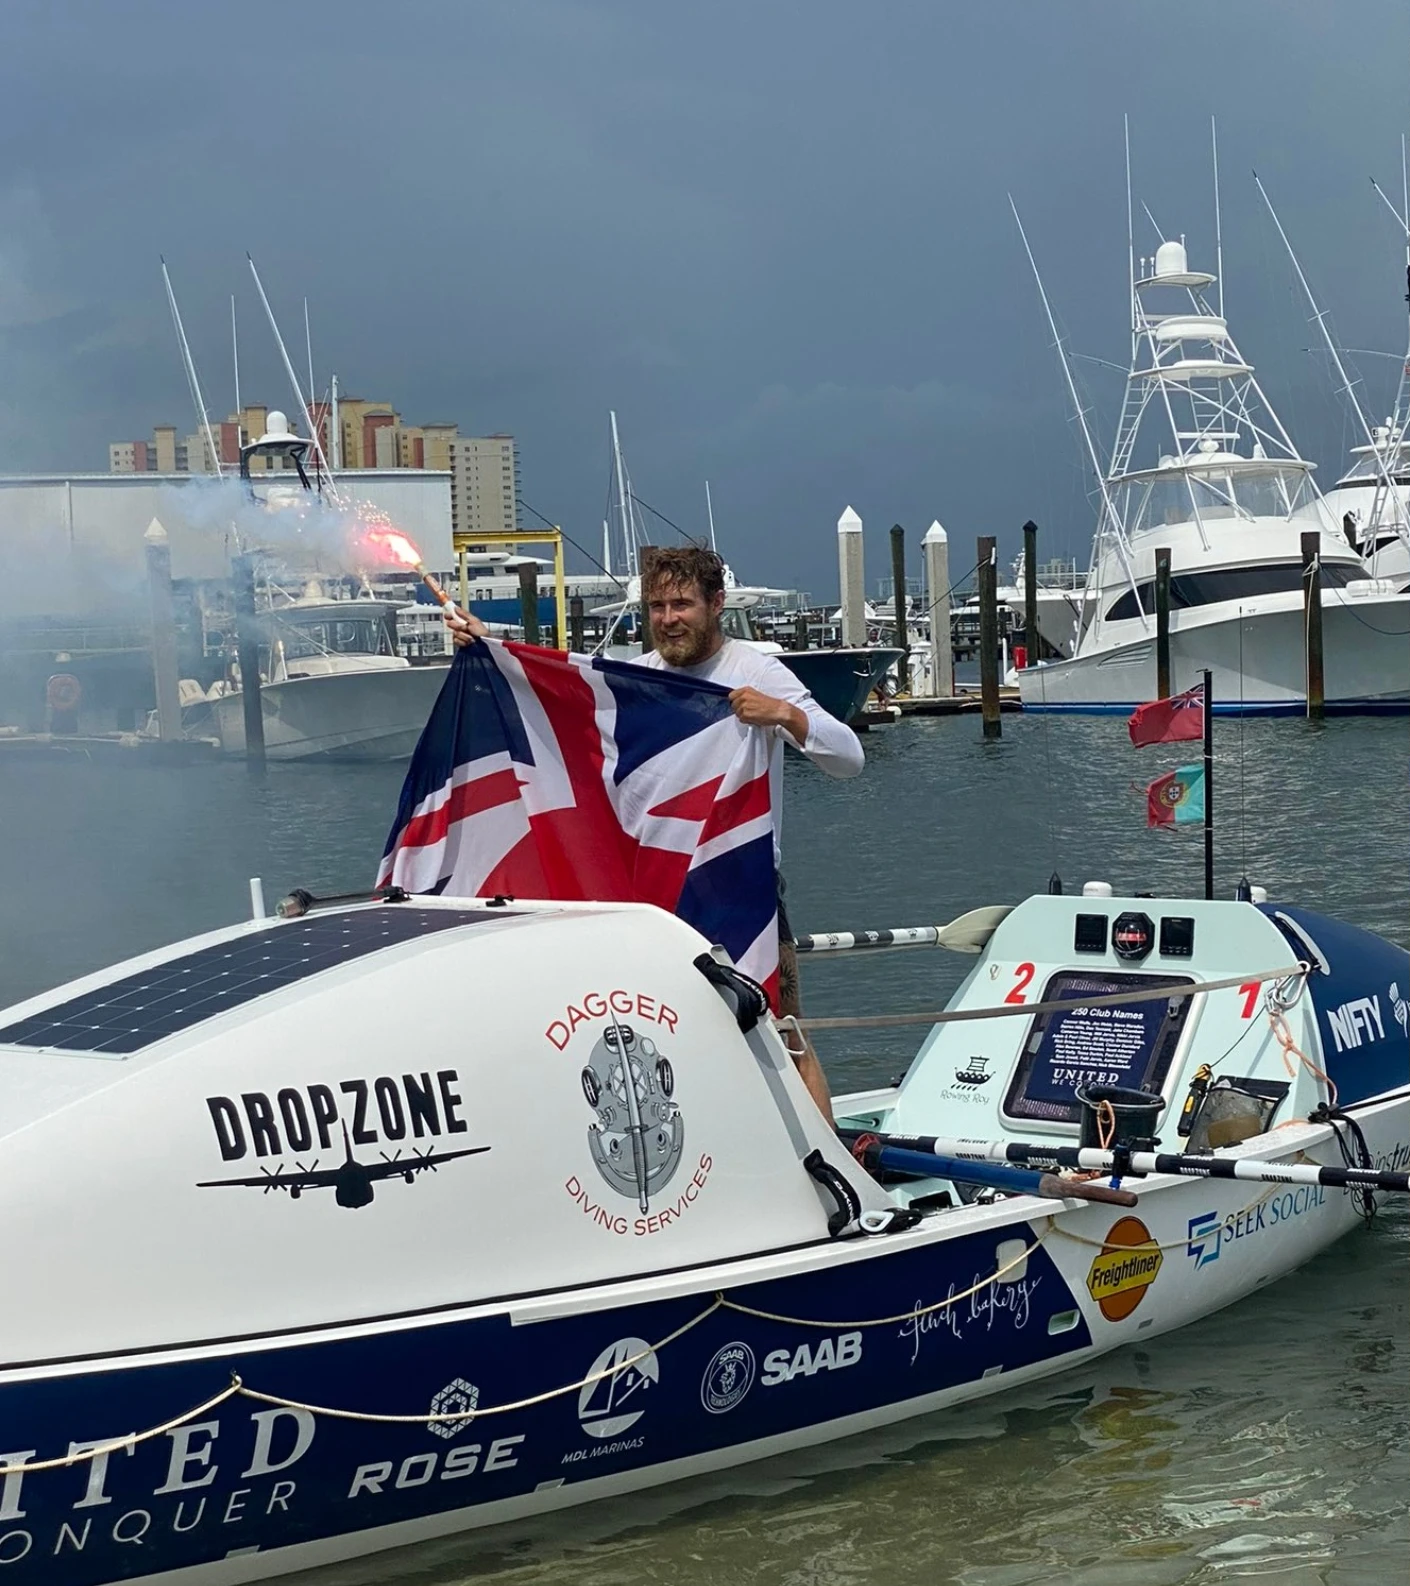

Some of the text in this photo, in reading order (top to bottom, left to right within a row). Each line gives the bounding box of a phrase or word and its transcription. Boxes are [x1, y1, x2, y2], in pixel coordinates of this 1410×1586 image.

[1004, 961, 1036, 1004] 2
[545, 989, 679, 1051] DAGGER
[1071, 1007, 1144, 1020] 250 Club Names
[1326, 994, 1385, 1053] NIFTY
[1053, 1068, 1120, 1083] UNITED
[206, 1069, 468, 1161] DROPZONE
[565, 1153, 713, 1237] DIVING SERVICES
[1224, 1184, 1326, 1243] SEEK SOCIAL
[1091, 1253, 1160, 1289] Freightliner
[966, 1272, 1043, 1332] bakery
[718, 1348, 745, 1365] SAAB
[761, 1331, 863, 1386] SAAB
[347, 1434, 526, 1498] ROSE
[561, 1436, 646, 1464] MDL MARINAS
